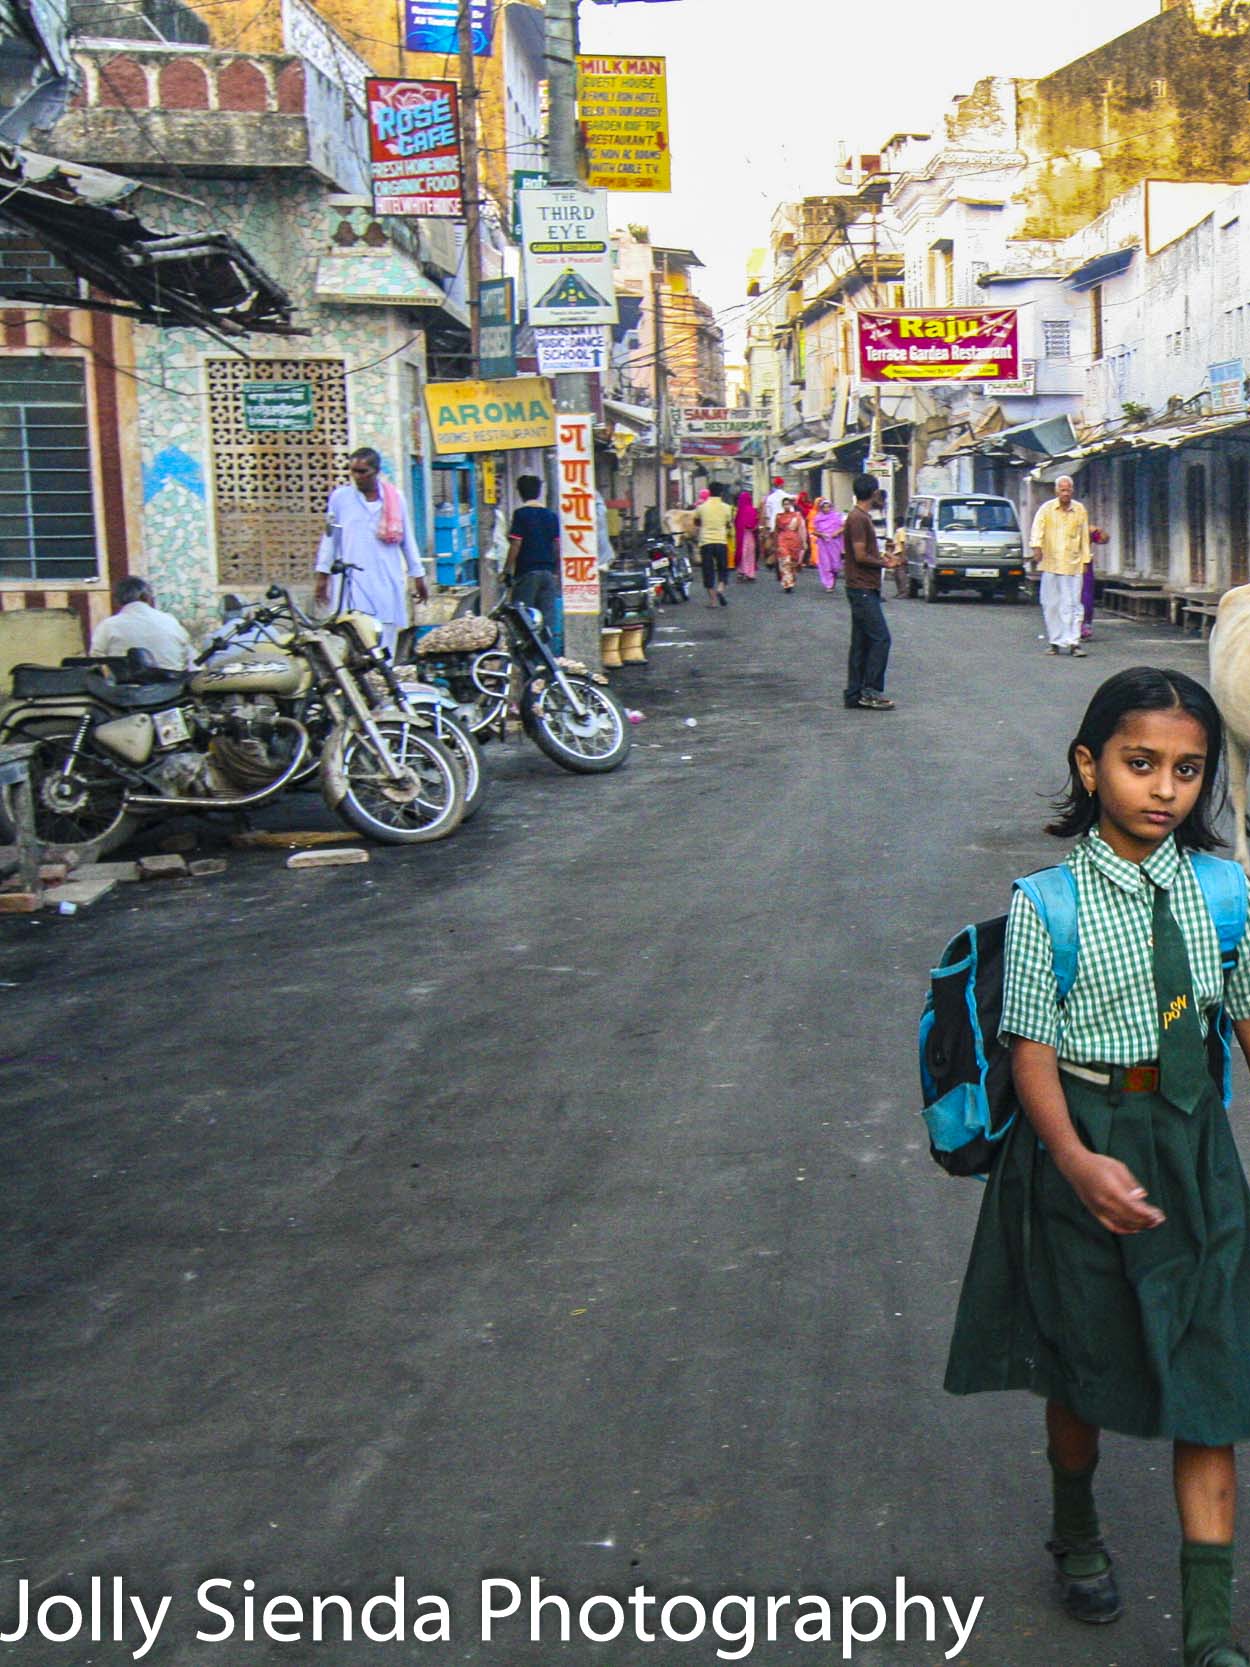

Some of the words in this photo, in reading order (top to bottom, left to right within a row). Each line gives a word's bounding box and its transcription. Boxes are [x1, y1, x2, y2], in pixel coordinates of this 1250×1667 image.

[581, 60, 621, 75] MILK
[627, 61, 662, 75] MAN
[620, 78, 657, 89] HOUSE
[634, 93, 660, 104] HOTEL
[376, 98, 457, 141] ROSE
[398, 122, 462, 156] CAFE
[590, 134, 654, 146] RESTAURANT
[372, 159, 404, 179] FRESH
[405, 155, 460, 176] HOMEMADE
[617, 163, 642, 174] CABLE
[374, 178, 426, 197] ORGANIC
[427, 174, 459, 192] FOOD
[553, 192, 577, 202] THE
[536, 206, 595, 221] THIRD
[547, 223, 587, 240] EYE
[898, 316, 979, 344] Raju
[543, 349, 592, 361] SCHOOL
[865, 345, 908, 362] Terrace
[908, 345, 950, 362] Garden
[951, 344, 1014, 362] Restaurant
[438, 399, 551, 427] AROMA
[683, 408, 730, 421] SANJAY
[754, 408, 772, 419] TOP
[474, 426, 549, 442] RESTAURANT
[703, 420, 769, 433] RESTAURANT
[563, 556, 597, 583] घाट
